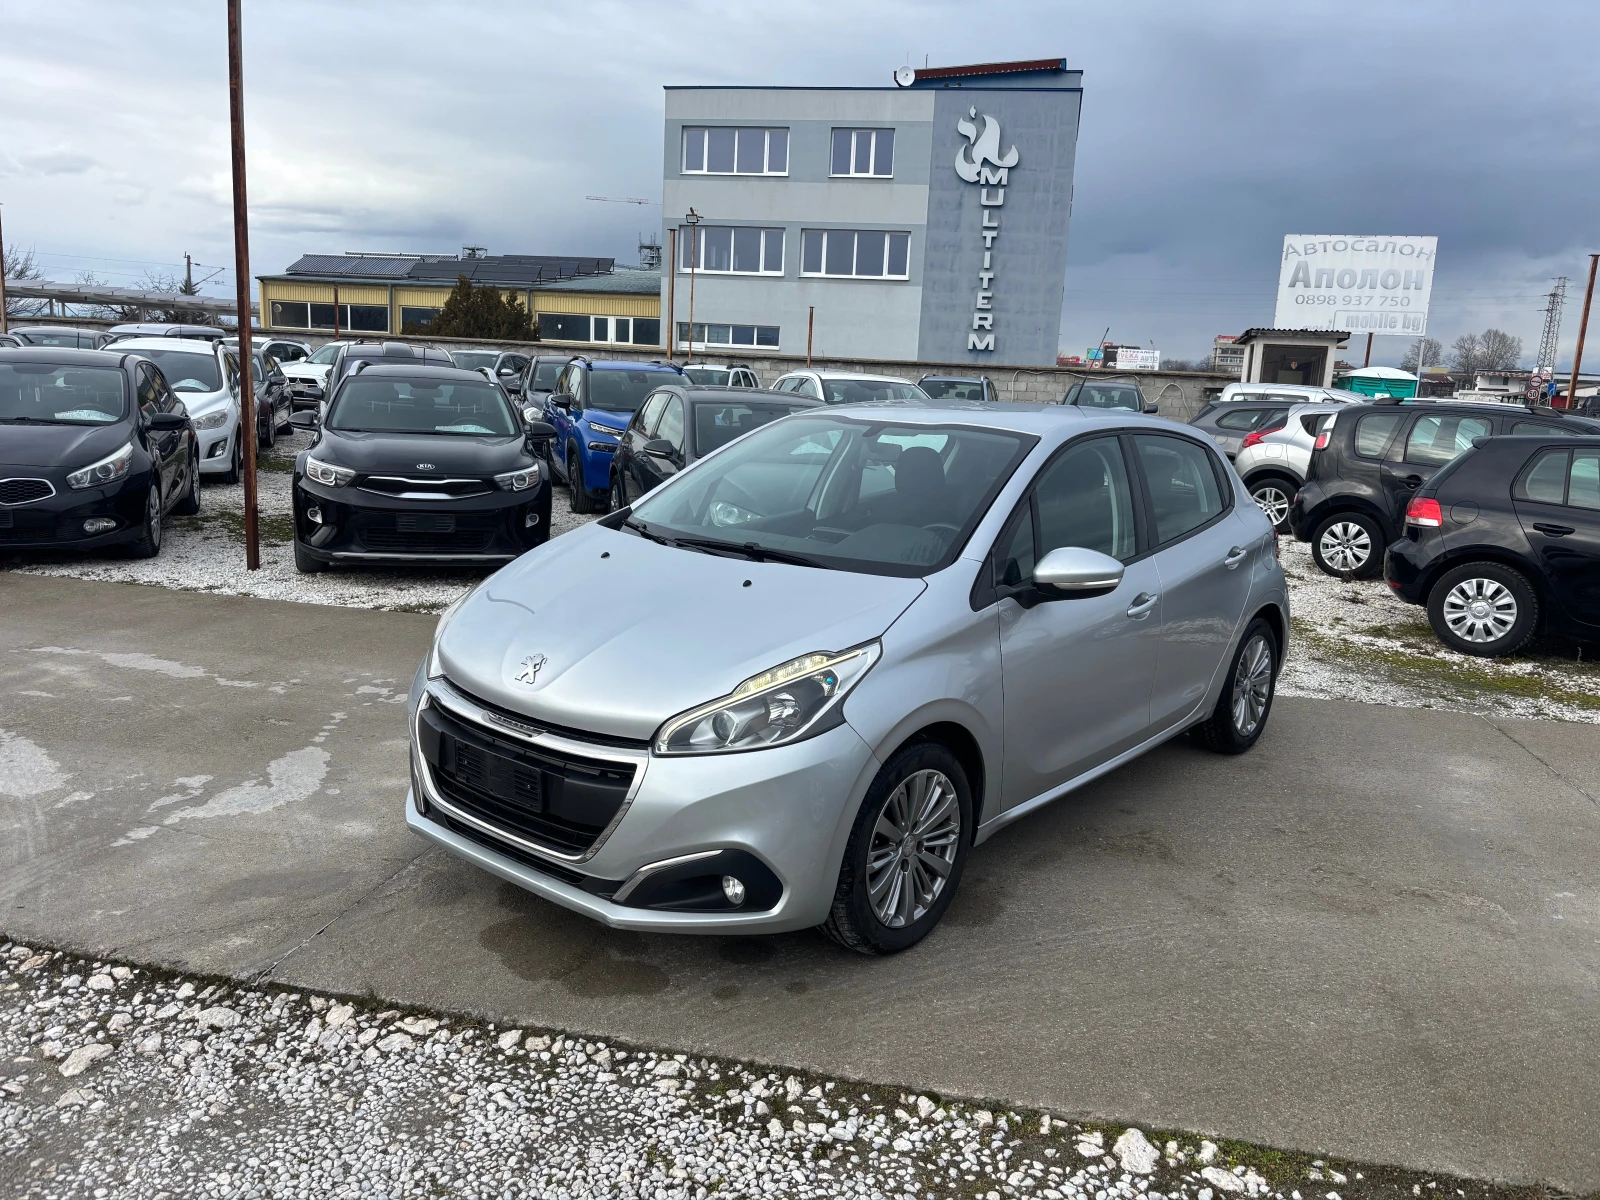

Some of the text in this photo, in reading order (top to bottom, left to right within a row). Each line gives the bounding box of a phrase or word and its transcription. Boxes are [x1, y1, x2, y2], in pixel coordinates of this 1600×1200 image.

[968, 167, 1009, 351] MULTITERM
[1284, 239, 1433, 261] Автосалон
[1287, 260, 1425, 291] Аполон
[1295, 294, 1411, 307] 0898 937 750
[1345, 312, 1422, 332] mobile bg
[1528, 390, 1537, 398] 50
